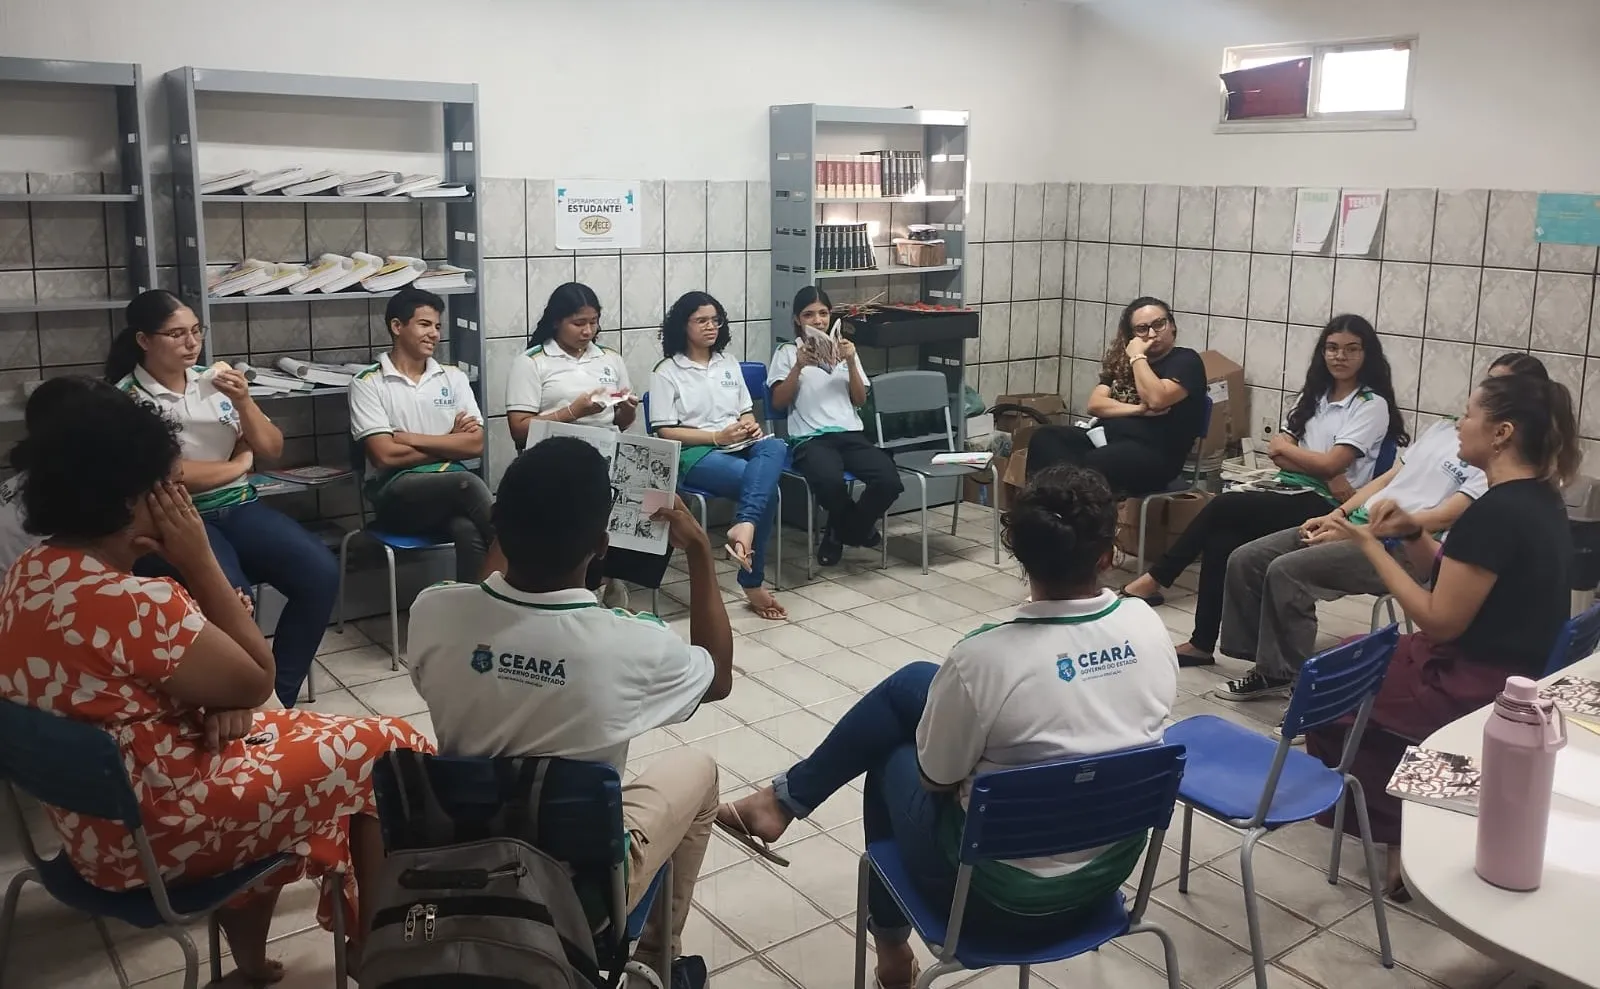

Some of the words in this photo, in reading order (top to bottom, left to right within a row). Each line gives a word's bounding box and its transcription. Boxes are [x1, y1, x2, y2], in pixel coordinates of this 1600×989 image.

[567, 205, 622, 213] ESTUDANTE!
[584, 218, 609, 232] SPAECE
[1078, 640, 1136, 668] CEARÁ
[499, 653, 566, 679] CEARÁ
[1080, 665, 1107, 675] GOVERNO
[1106, 662, 1116, 670] DO
[1116, 658, 1138, 668] ESTADO
[498, 667, 530, 678] GOVERNO
[530, 673, 540, 681] DO
[540, 675, 566, 686] ESTADO
